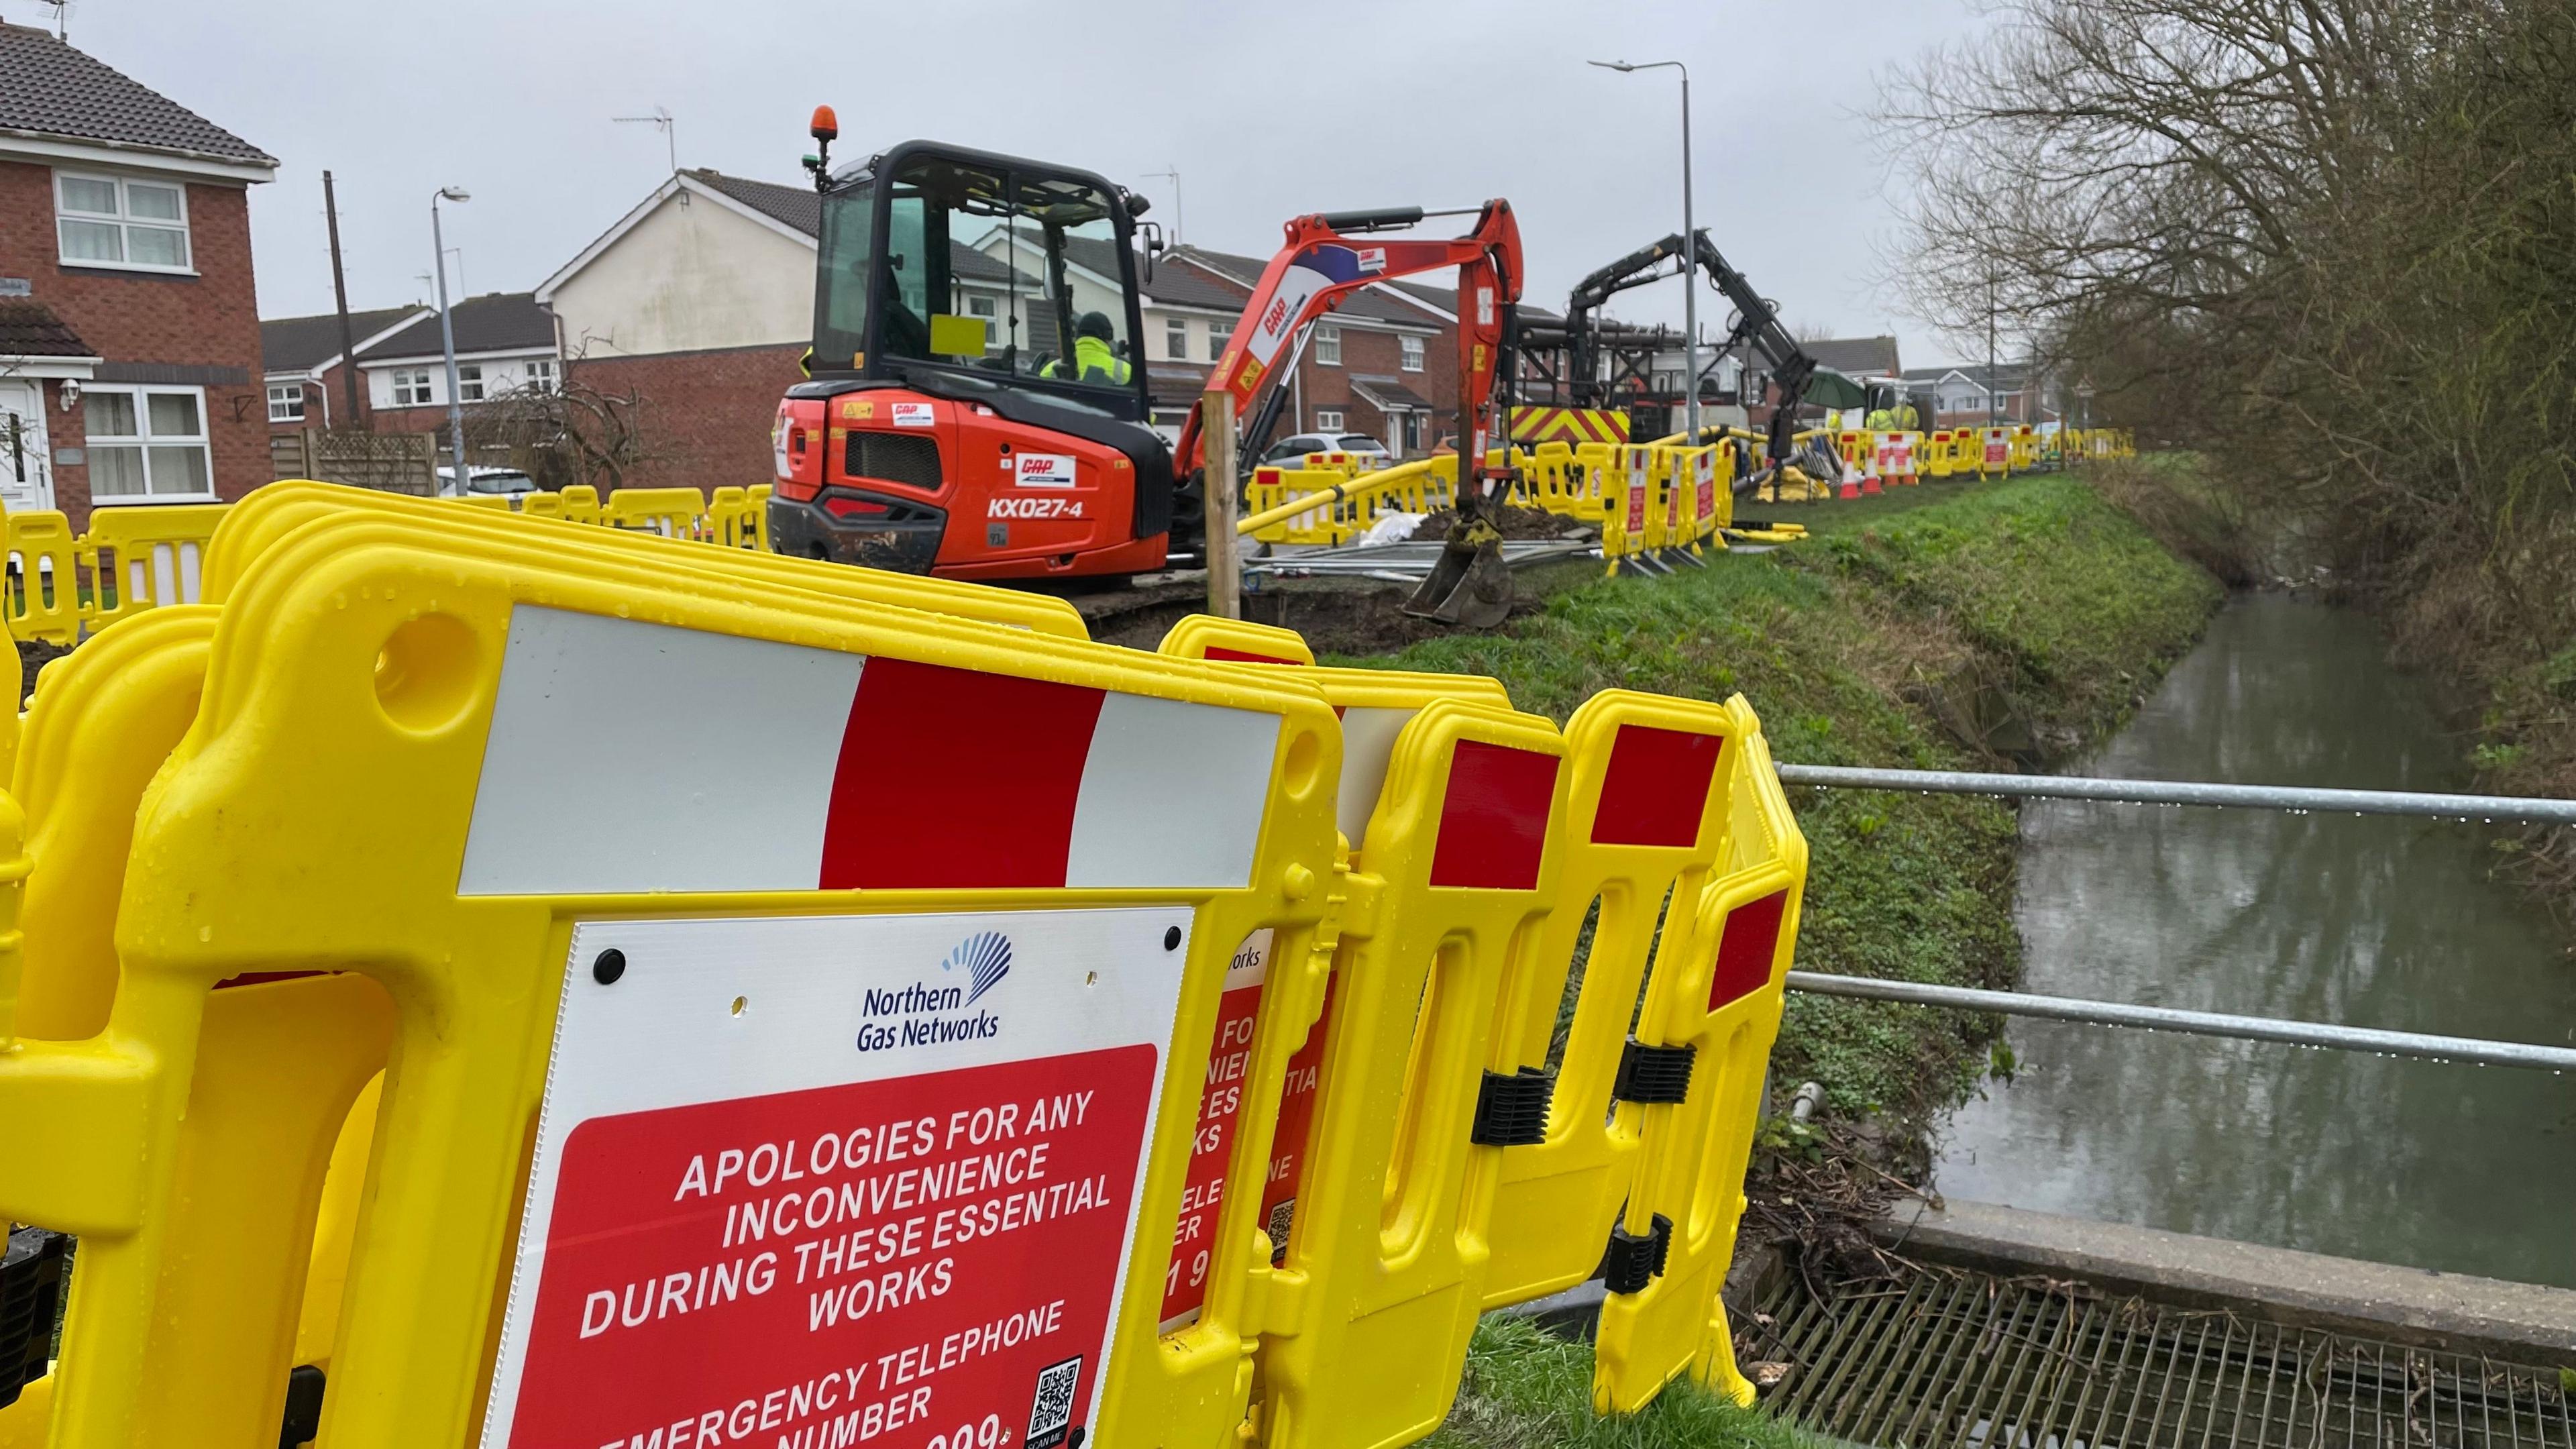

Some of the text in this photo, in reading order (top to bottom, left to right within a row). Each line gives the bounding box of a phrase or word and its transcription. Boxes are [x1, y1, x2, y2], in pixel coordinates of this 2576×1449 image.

[896, 405, 918, 415] GAP
[1022, 459, 1054, 474] GAP
[987, 498, 1083, 518] KX027-4
[863, 981, 961, 1017] Northern
[857, 1009, 999, 1052] Gas Networks
[674, 1089, 1094, 1201] APOLOGIES FOR ANY
[722, 1142, 1049, 1248] INCONVENIENCE
[579, 1174, 1110, 1340] DURING THESE ESSENTIAL
[809, 1256, 954, 1332] WORKS
[599, 1299, 1065, 1449] MERGENCY TELEPHONE
[1050, 1430, 1063, 1444] ME
